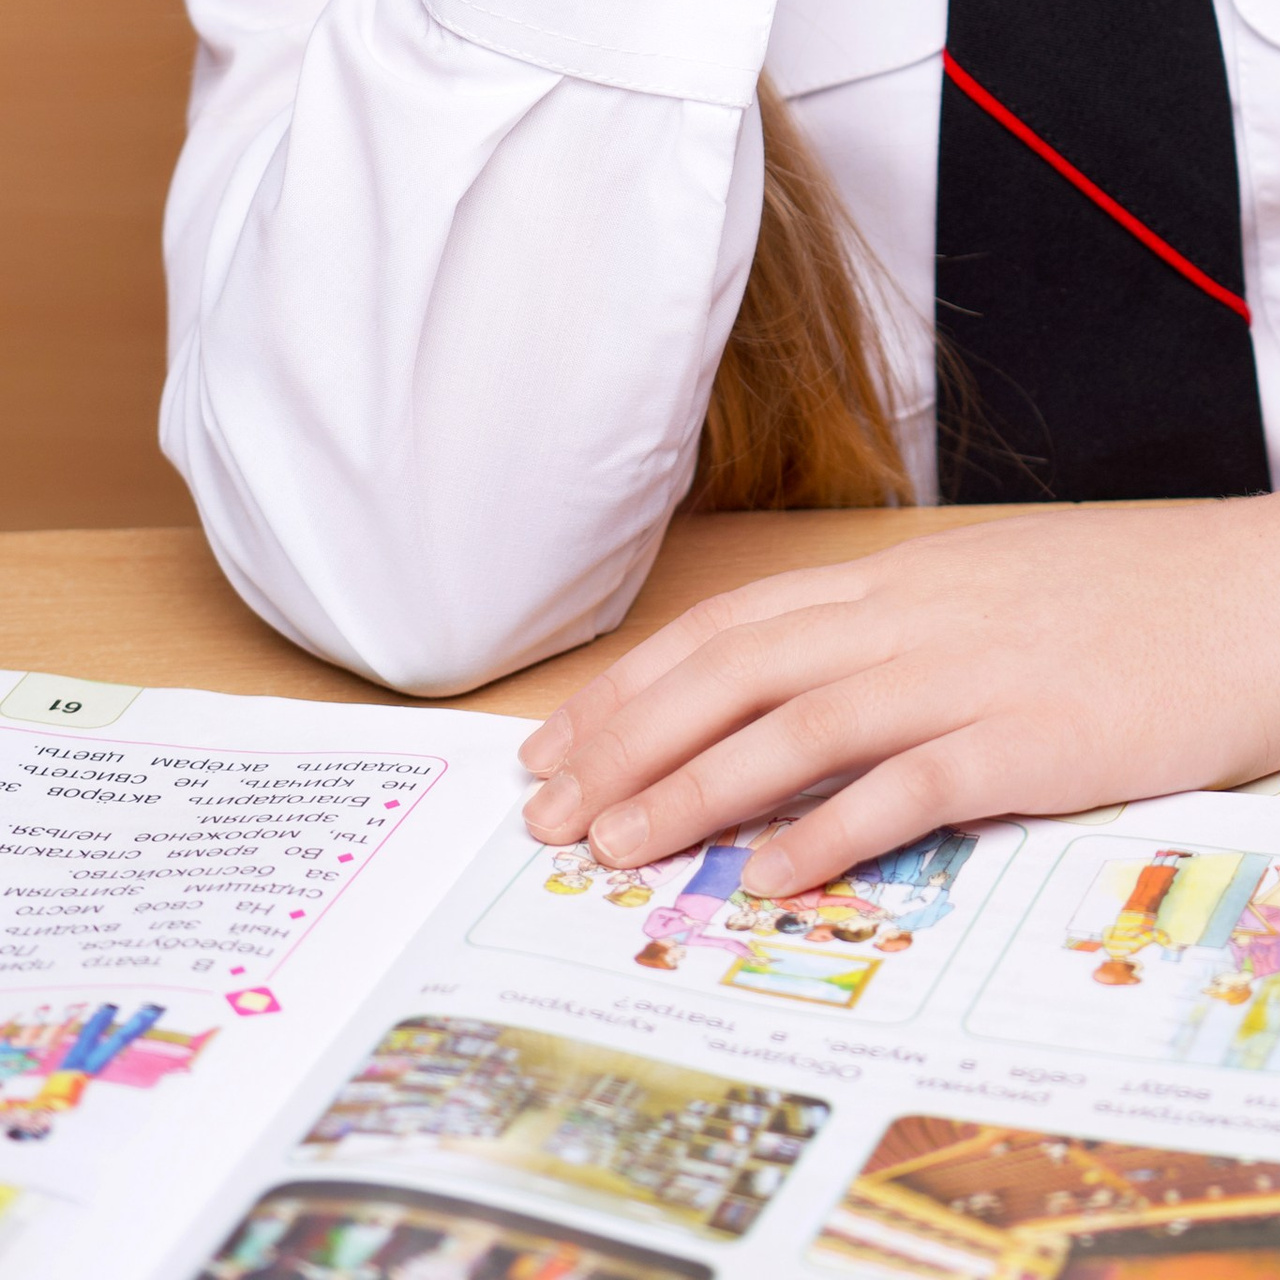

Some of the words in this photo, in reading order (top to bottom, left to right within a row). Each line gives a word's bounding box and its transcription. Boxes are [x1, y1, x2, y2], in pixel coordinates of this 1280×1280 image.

[47, 698, 83, 714] 61
[32, 744, 125, 765] цветы.
[149, 755, 269, 774] актёрам
[296, 760, 431, 776] подарить
[17, 763, 148, 787] свистеть.
[173, 777, 209, 789] не
[238, 776, 355, 789] кричать,
[381, 780, 417, 792] не
[46, 785, 162, 806] актёров
[188, 794, 370, 808] Благодарить
[195, 811, 339, 824] зрителям.
[366, 817, 385, 828] и
[7, 823, 113, 842] нельзя.
[134, 827, 301, 843] мороженое
[328, 830, 369, 845] ты,
[166, 845, 259, 859] время
[284, 846, 324, 860] Во
[68, 865, 276, 882] беспокойство.
[306, 869, 340, 881] за
[3, 885, 144, 897] зрителям
[15, 904, 105, 916] место
[133, 900, 204, 915] своё
[236, 901, 276, 916] На
[5, 923, 122, 937] входить
[149, 920, 202, 931] зал
[228, 923, 291, 940] ный
[81, 956, 160, 969] театр
[611, 995, 736, 1037] театре?
[770, 1031, 788, 1044] в
[1009, 1067, 1087, 1088] себя
